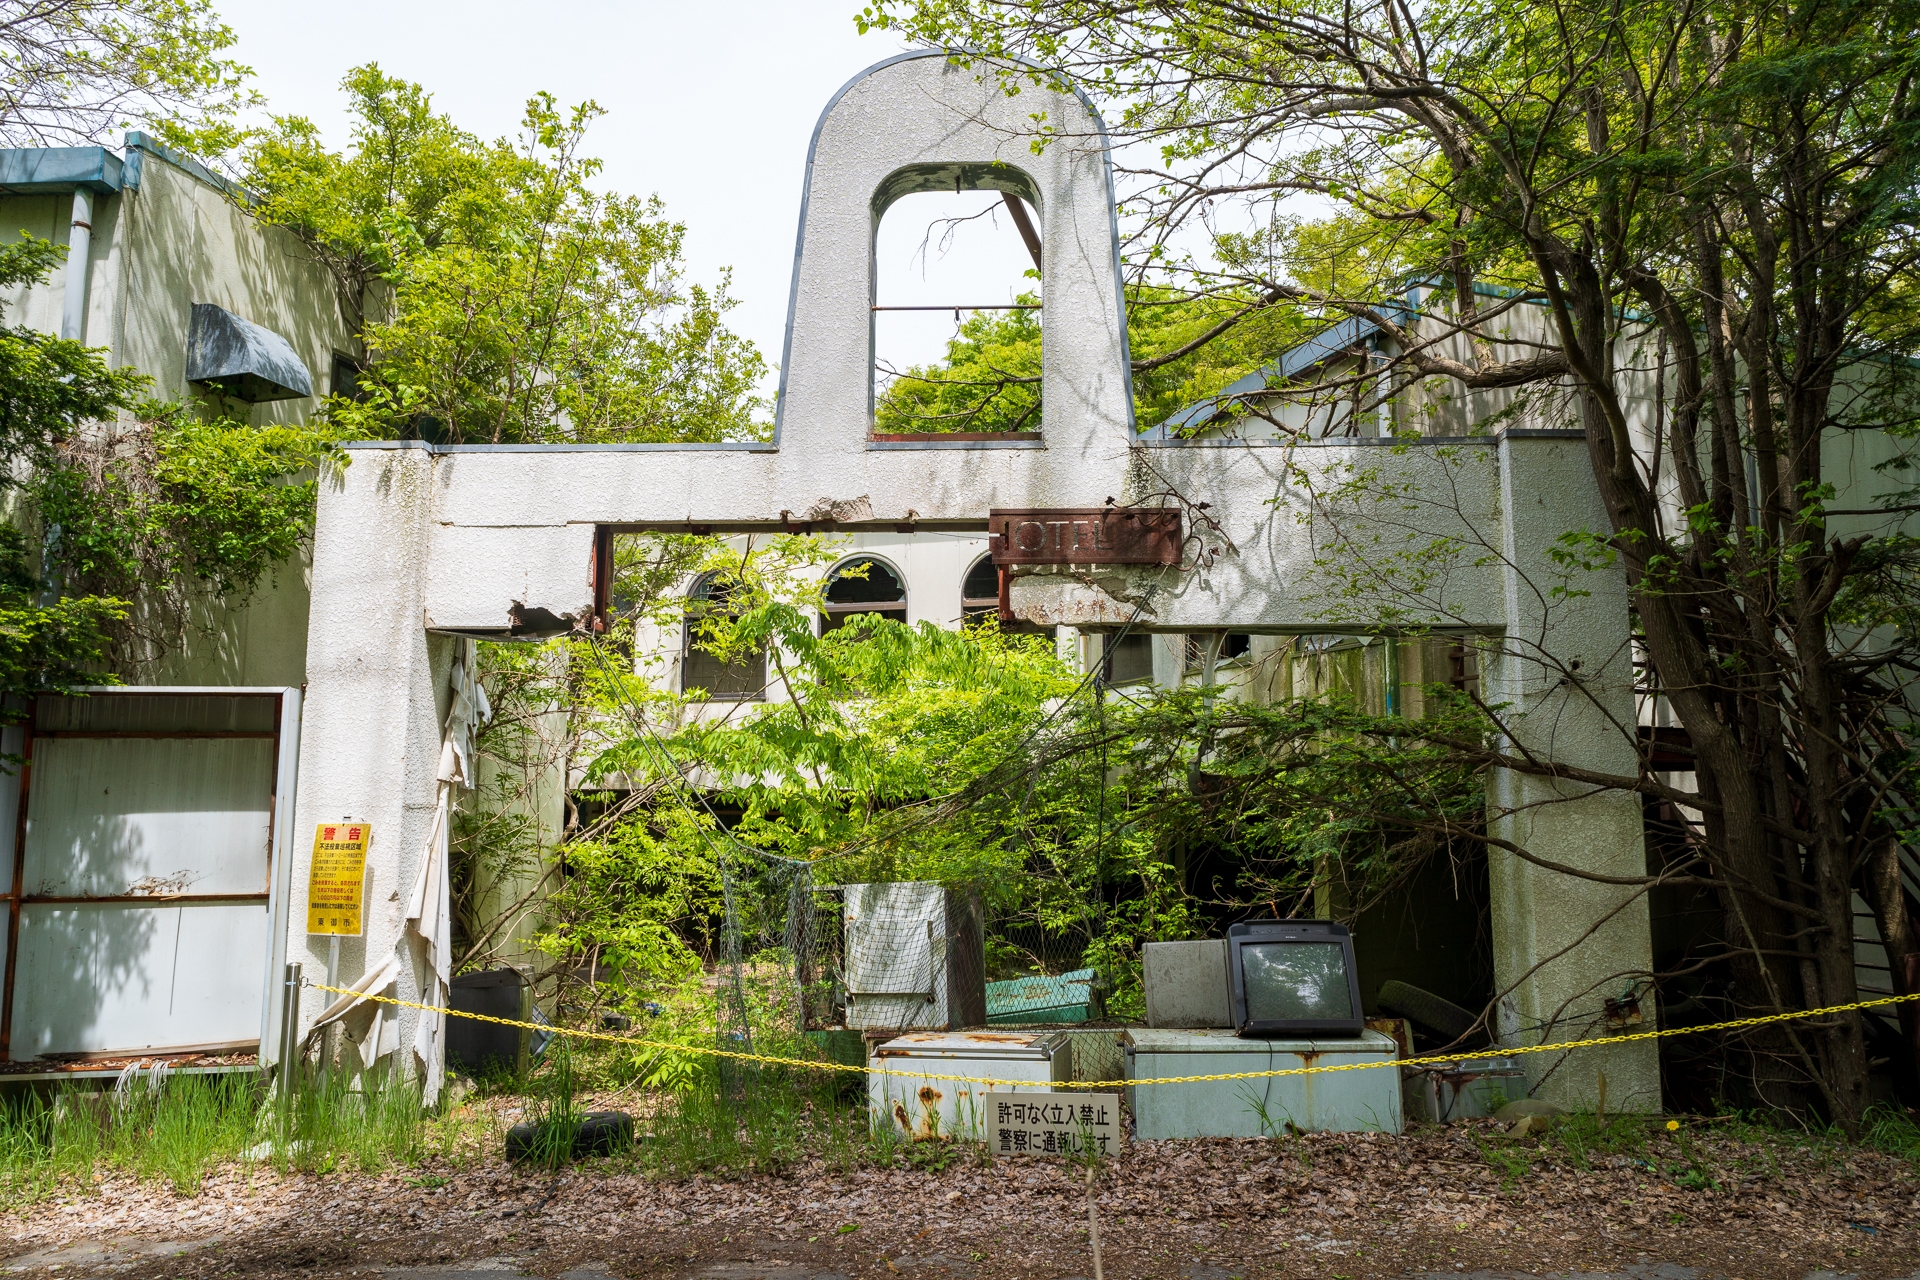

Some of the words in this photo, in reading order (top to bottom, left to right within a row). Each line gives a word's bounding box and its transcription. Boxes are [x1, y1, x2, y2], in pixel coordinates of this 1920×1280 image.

[323, 827, 361, 841] 警告
[317, 917, 350, 927] 東御市
[998, 1102, 1110, 1126] 許可なく立入禁止
